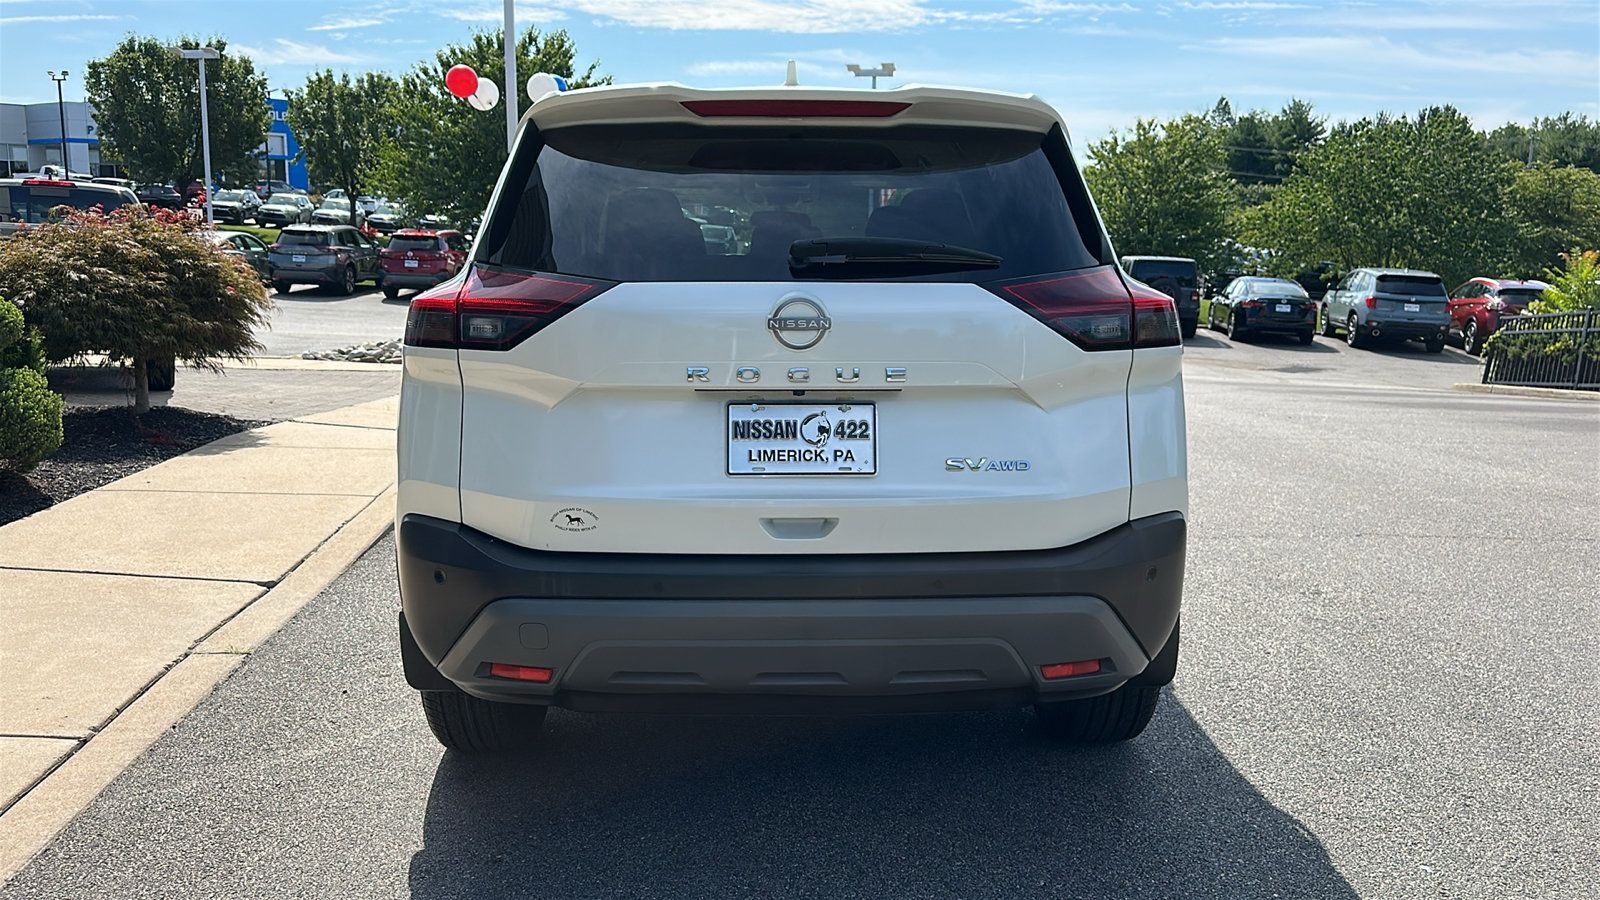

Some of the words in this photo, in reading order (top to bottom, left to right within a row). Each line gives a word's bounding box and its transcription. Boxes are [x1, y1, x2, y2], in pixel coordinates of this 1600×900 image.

[769, 318, 830, 328] NISSAN
[686, 367, 907, 383] ROGUE
[732, 419, 798, 440] NISSAN
[833, 419, 870, 440] 422
[748, 449, 829, 464] LIMERICK,
[833, 449, 856, 463] PA
[945, 457, 987, 472] SV
[985, 460, 1031, 472] AWD
